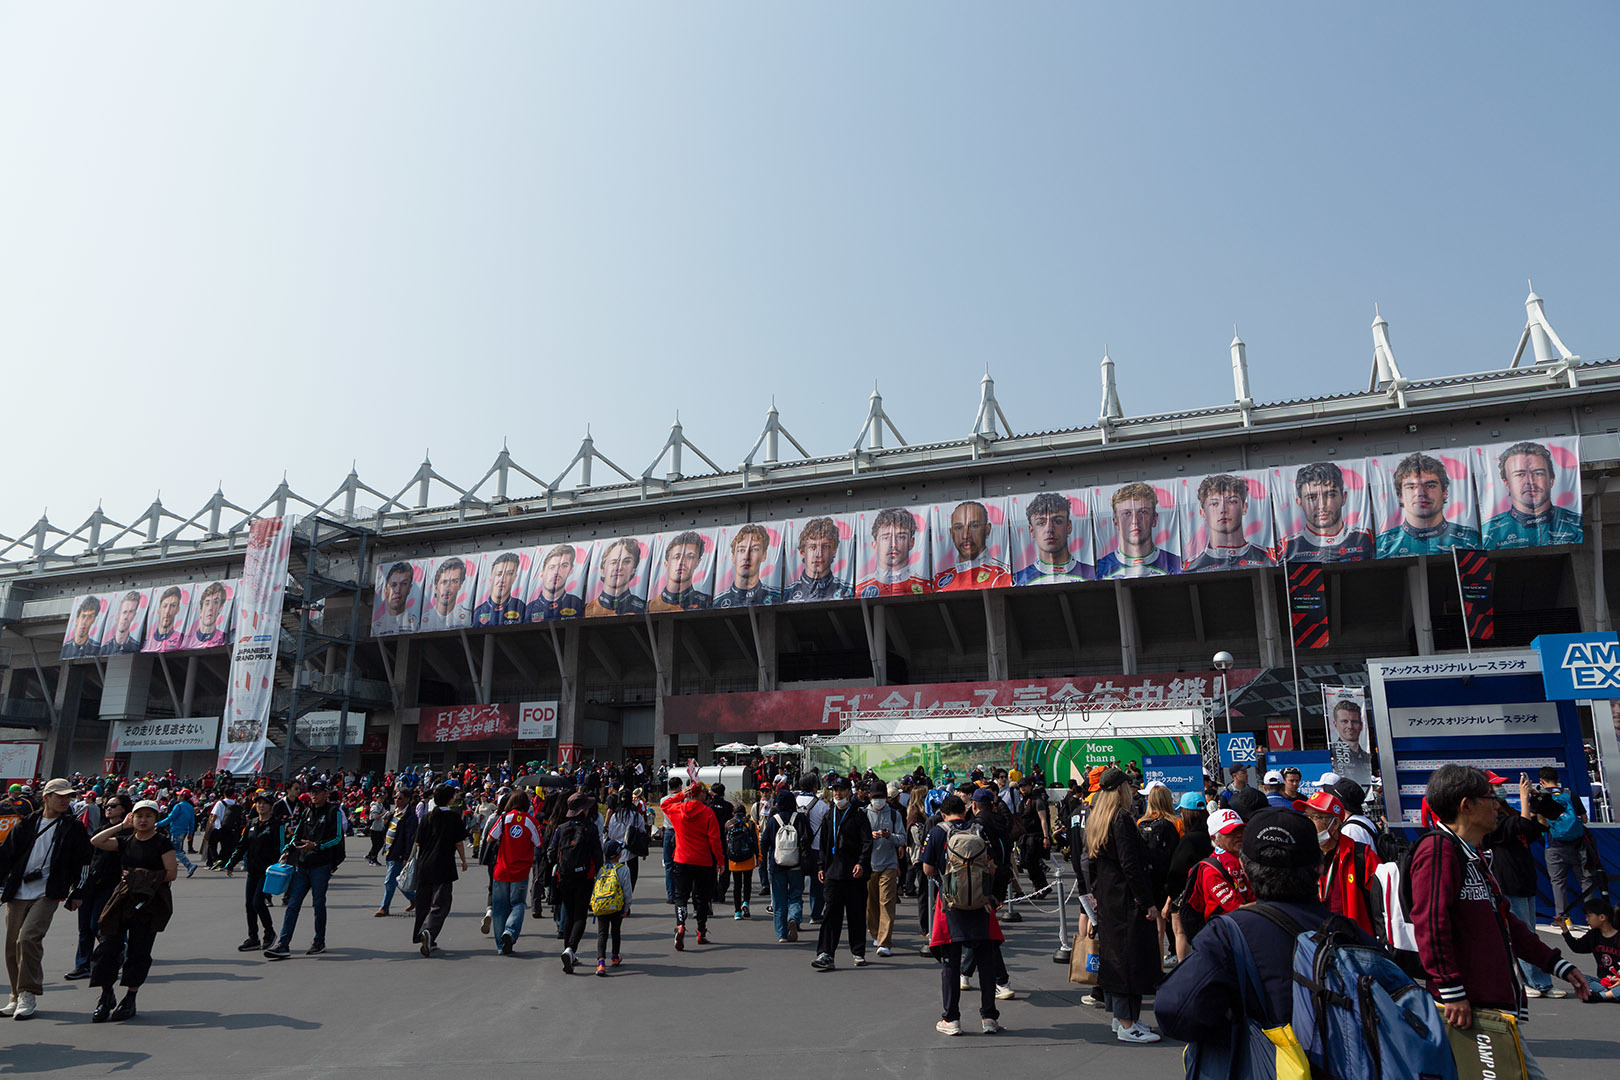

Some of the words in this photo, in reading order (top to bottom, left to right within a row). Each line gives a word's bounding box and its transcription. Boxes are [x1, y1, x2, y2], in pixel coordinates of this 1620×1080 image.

[1561, 641, 1620, 668] AM
[523, 708, 555, 722] FOD
[1227, 737, 1256, 751] AM
[1273, 730, 1286, 746] V
[1086, 743, 1113, 752] More
[1232, 749, 1256, 761] EX
[1222, 811, 1237, 822] 16
[1476, 1034, 1495, 1068] CAMP
[1482, 1069, 1496, 1080] O
